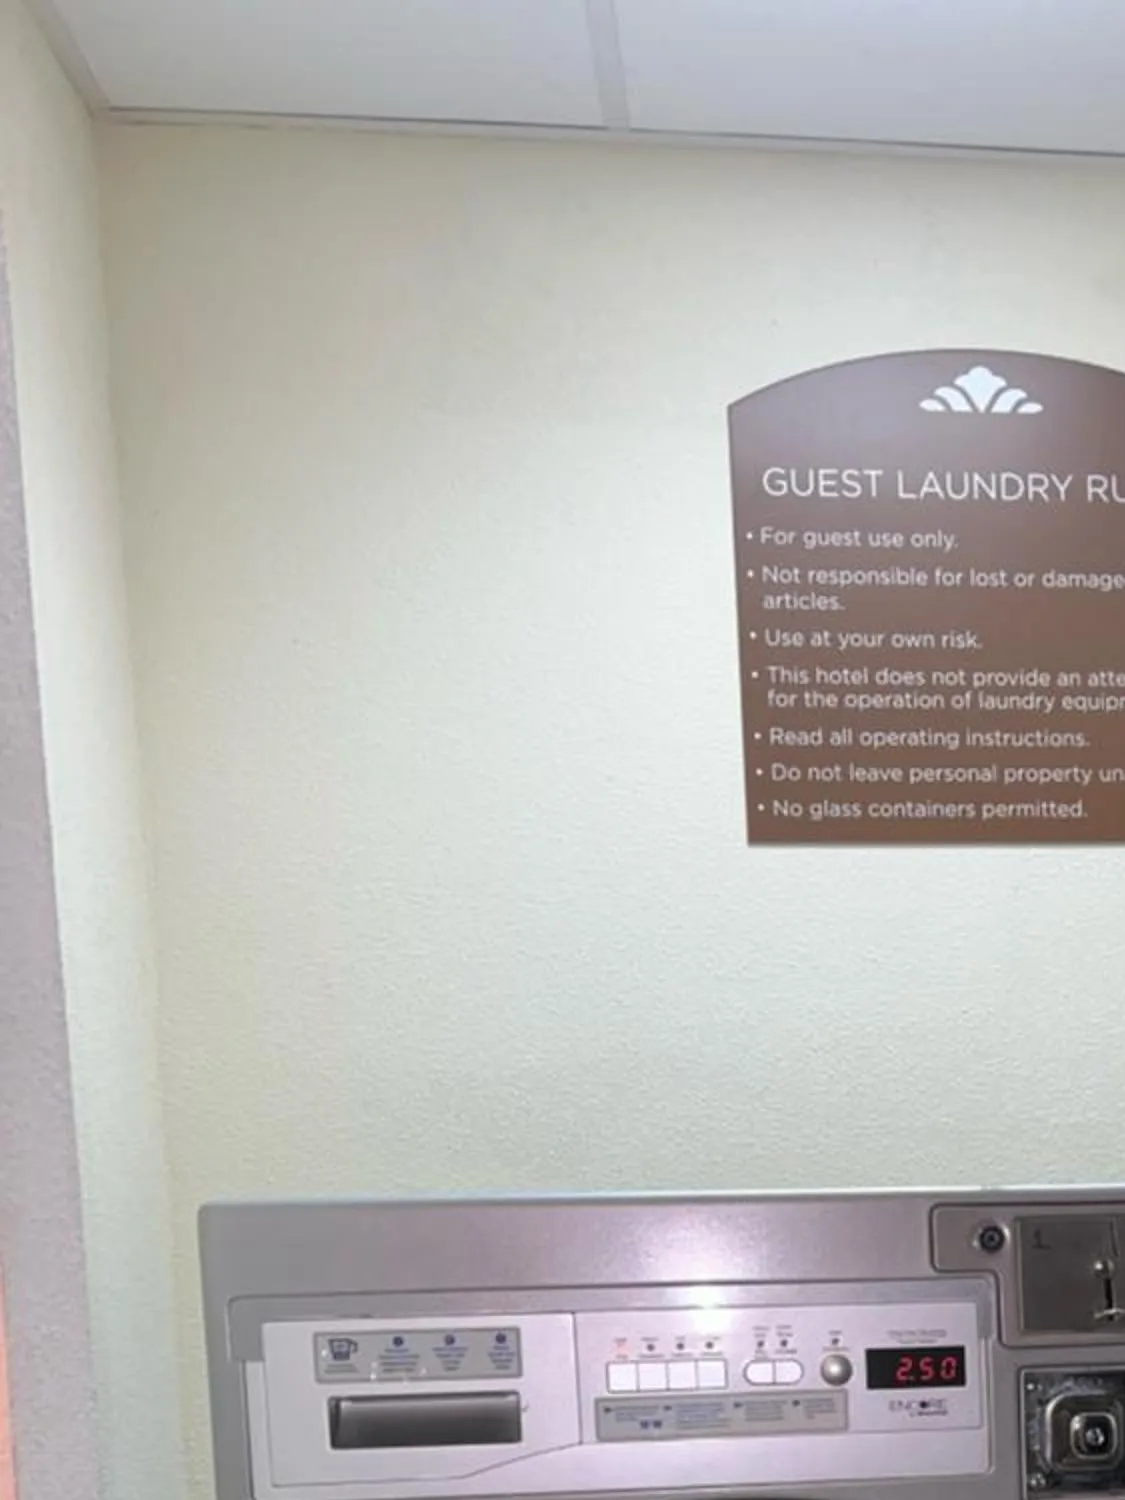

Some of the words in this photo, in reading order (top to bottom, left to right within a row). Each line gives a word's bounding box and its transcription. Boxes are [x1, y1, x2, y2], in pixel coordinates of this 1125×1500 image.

[762, 467, 883, 498] GUEST
[898, 470, 1073, 503] LAUNDRY
[760, 526, 796, 545] For
[803, 530, 861, 549] guest
[868, 532, 904, 548] use
[910, 530, 958, 552] only.
[762, 566, 800, 584] Not
[808, 567, 928, 587] responsible
[935, 567, 963, 586] for
[970, 568, 1008, 587] lost
[1013, 573, 1035, 587] or
[763, 591, 845, 610] articles.
[765, 628, 804, 647] Use
[810, 630, 831, 647] at
[838, 633, 885, 651] your
[891, 633, 935, 648] own
[942, 631, 982, 649] risk.
[767, 665, 810, 684] This
[816, 666, 869, 686] hotel
[875, 668, 926, 686] does
[932, 669, 967, 687] not
[972, 668, 1051, 689] provide
[1057, 672, 1081, 686] an
[768, 689, 798, 707] for
[804, 690, 838, 708] the
[843, 691, 945, 711] operation
[951, 690, 973, 710] of
[978, 691, 1056, 713] laundry
[769, 727, 823, 747] Read
[829, 727, 852, 746] all
[859, 728, 960, 750] operating
[966, 729, 1090, 747] instructions.
[771, 763, 801, 781] Do
[808, 764, 843, 782] not
[849, 763, 903, 782] leave
[909, 764, 997, 784] personal
[1004, 766, 1093, 785] property
[773, 800, 804, 817] No
[807, 800, 862, 821] glass
[868, 800, 976, 818] containers
[981, 800, 1087, 820] permitted.
